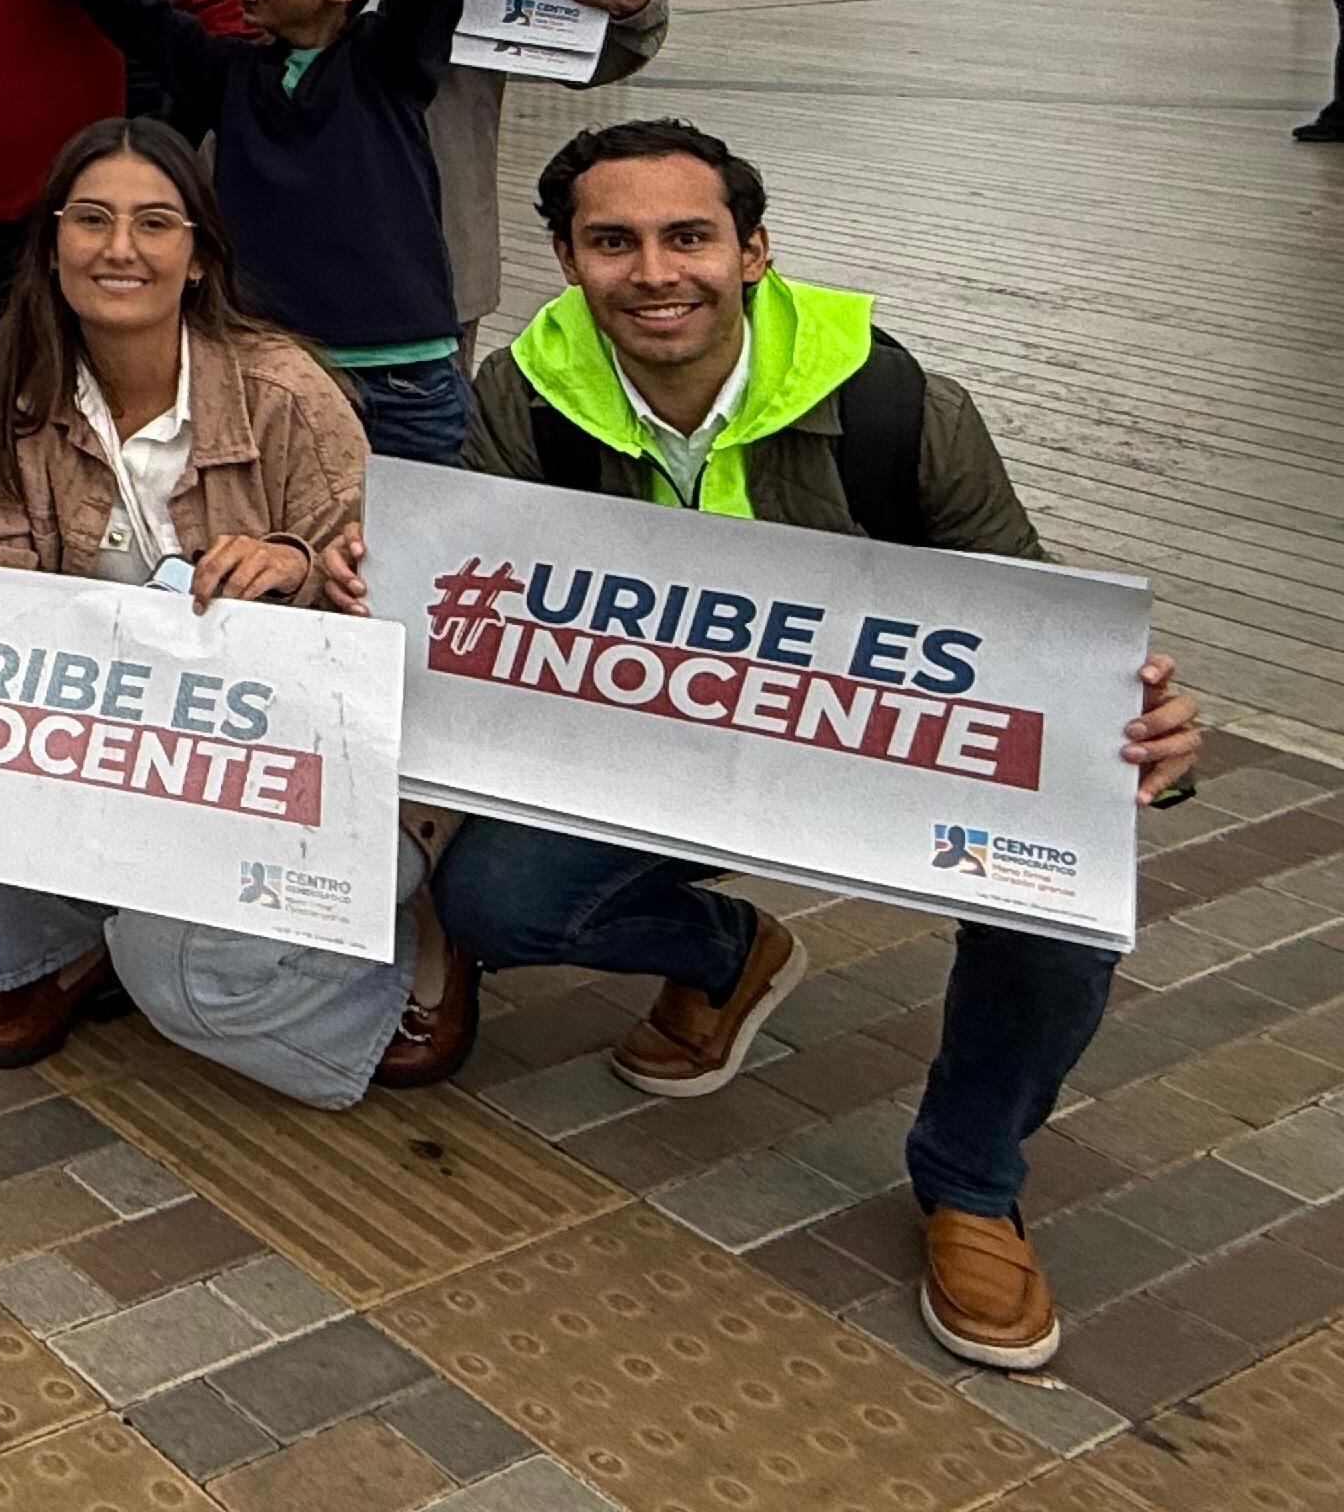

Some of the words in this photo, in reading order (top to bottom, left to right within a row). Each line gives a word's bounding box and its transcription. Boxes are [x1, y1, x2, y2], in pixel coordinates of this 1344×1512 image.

[427, 556, 825, 666] #URIBE
[849, 615, 985, 695] ES
[170, 669, 276, 743] ES
[490, 623, 1012, 777] INOCENTE
[285, 869, 353, 896] CENTRO
[992, 836, 1078, 866] CENTRO
